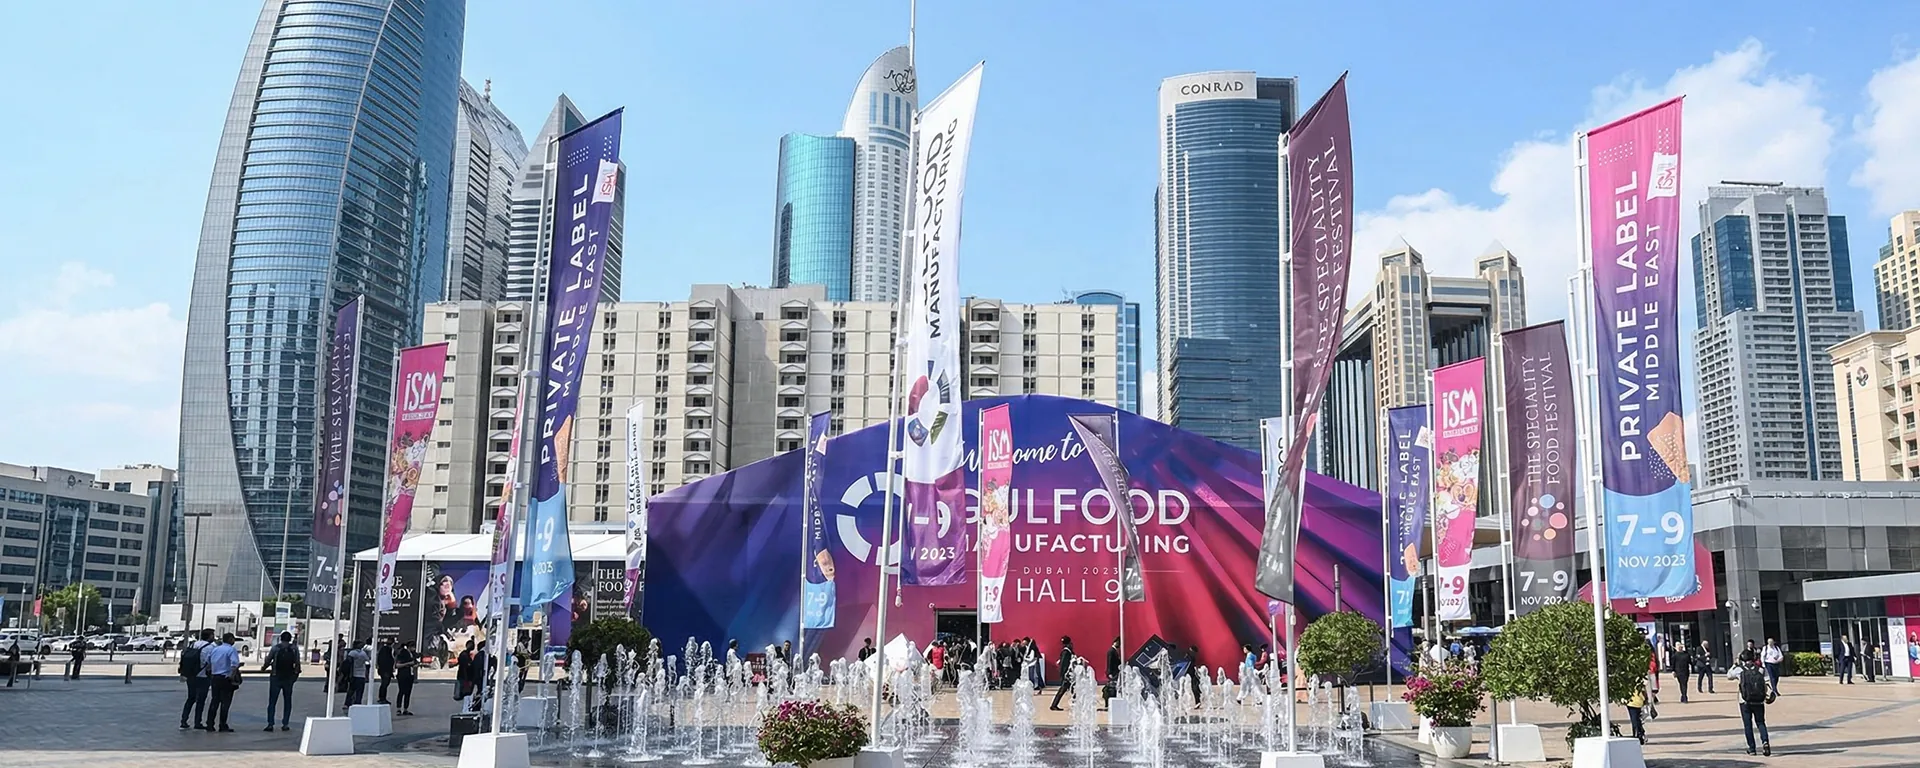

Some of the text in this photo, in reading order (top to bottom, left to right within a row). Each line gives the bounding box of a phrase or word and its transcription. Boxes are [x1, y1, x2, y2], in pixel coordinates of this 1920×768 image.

[1181, 81, 1244, 96] CONRAD
[1324, 136, 1343, 276] FESTIVAL
[930, 118, 958, 339] MANUFACTURING
[1307, 155, 1329, 311] SPECIALITY
[541, 173, 588, 464] PRIVATE LABEL
[562, 229, 599, 397] MIDDLE EAST
[1615, 171, 1641, 461] PRIVATE LABEL
[1644, 224, 1660, 400] MIDDLE EAST
[1521, 355, 1541, 487] THE SPECIALITY
[1540, 351, 1560, 485] FOOD FESTIVAL
[1061, 431, 1087, 461] to
[1399, 429, 1412, 483] LABEL
[964, 533, 1190, 554] UFACTUING
[1617, 511, 1685, 546] 7-9
[920, 546, 955, 560] 2023
[1023, 566, 1119, 575] DUBAI 2023
[1618, 554, 1686, 568] NOV 2023
[599, 568, 624, 580] THE
[1016, 578, 1121, 603] HALL 9
[1520, 569, 1569, 593] 7-9
[1520, 595, 1569, 606] NOV 202
